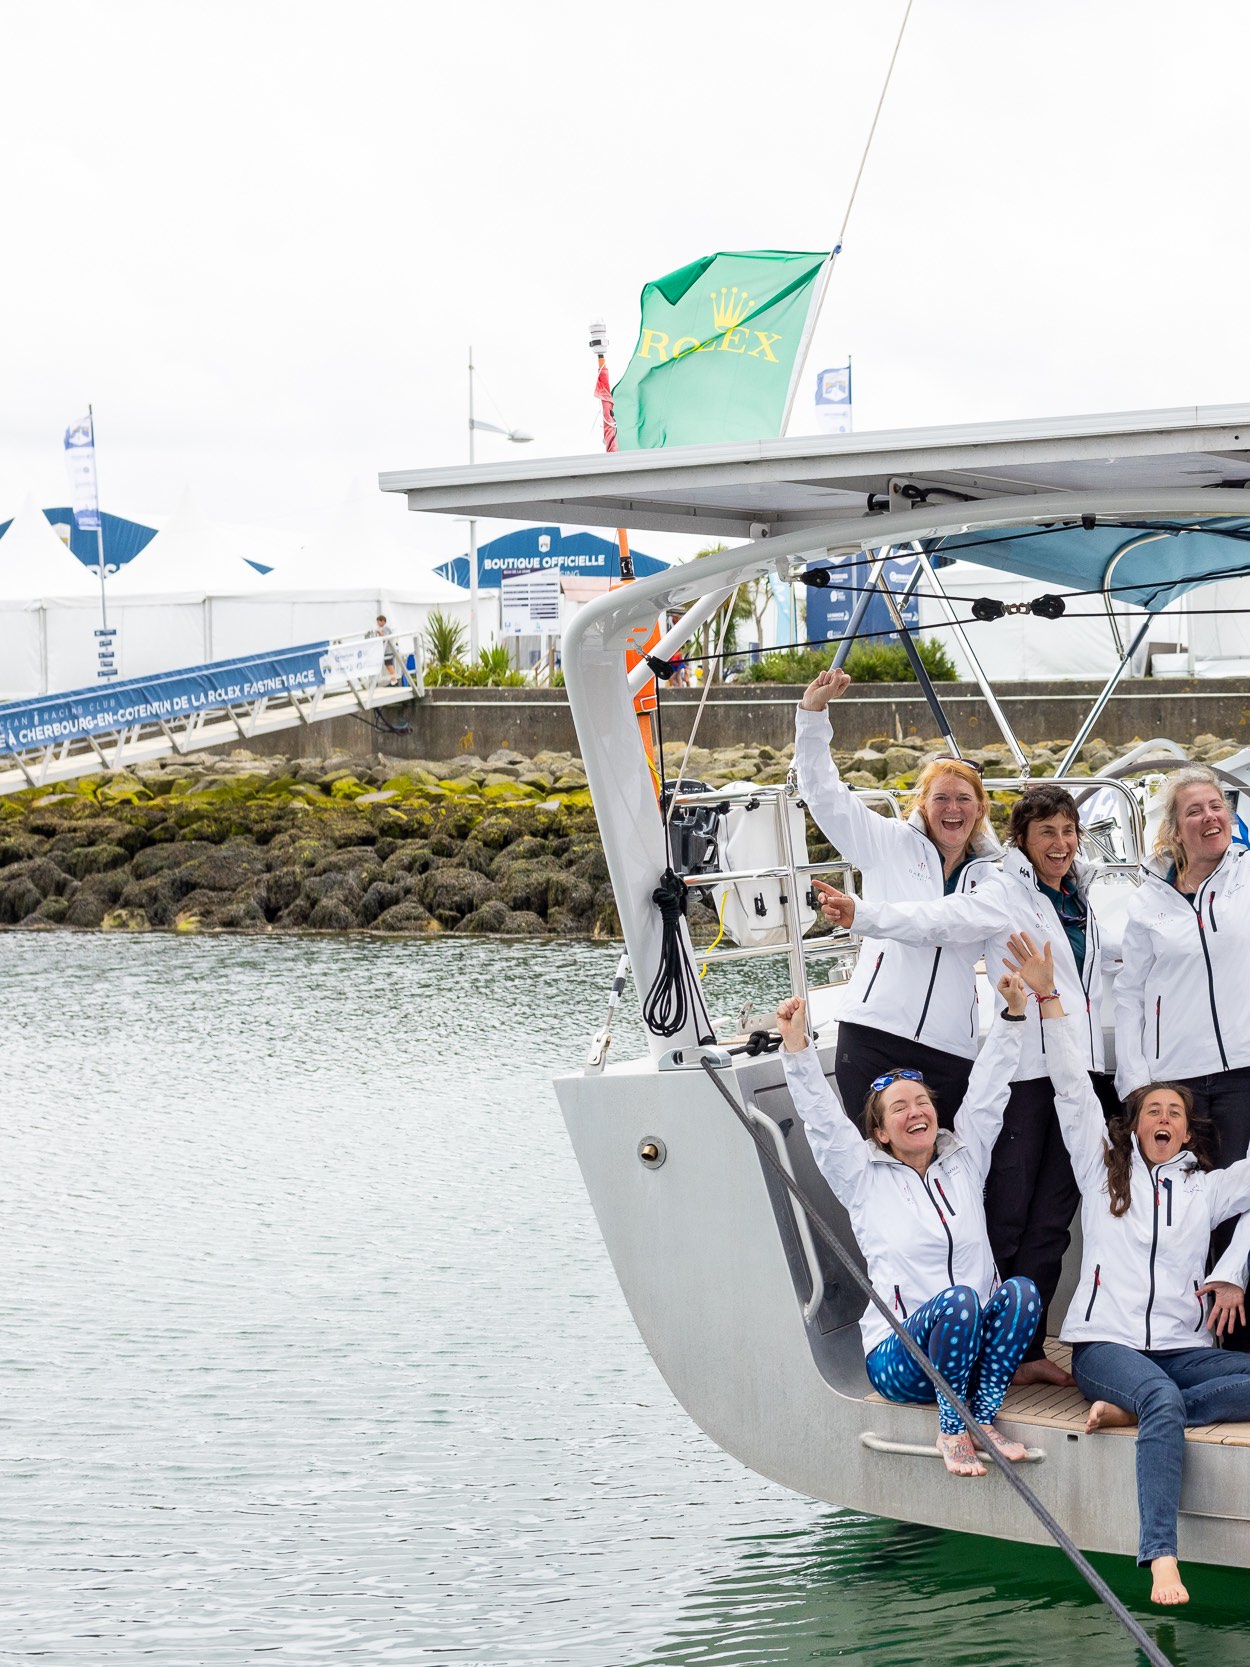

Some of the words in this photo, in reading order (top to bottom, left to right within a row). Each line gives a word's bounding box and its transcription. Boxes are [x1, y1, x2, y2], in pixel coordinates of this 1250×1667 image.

[638, 326, 782, 362] ROLEX
[484, 556, 540, 570] BOUTIQUE
[542, 554, 606, 569] OFFICIELLE
[19, 698, 171, 743] CHERBOURG-EN-COTENTIN
[173, 696, 189, 711] DE
[192, 693, 207, 707] LA
[208, 685, 241, 702] ROLEX
[244, 675, 287, 696] FASTNET
[288, 670, 315, 687] RACE
[43, 705, 83, 721] RACING
[89, 699, 116, 712] CLUB
